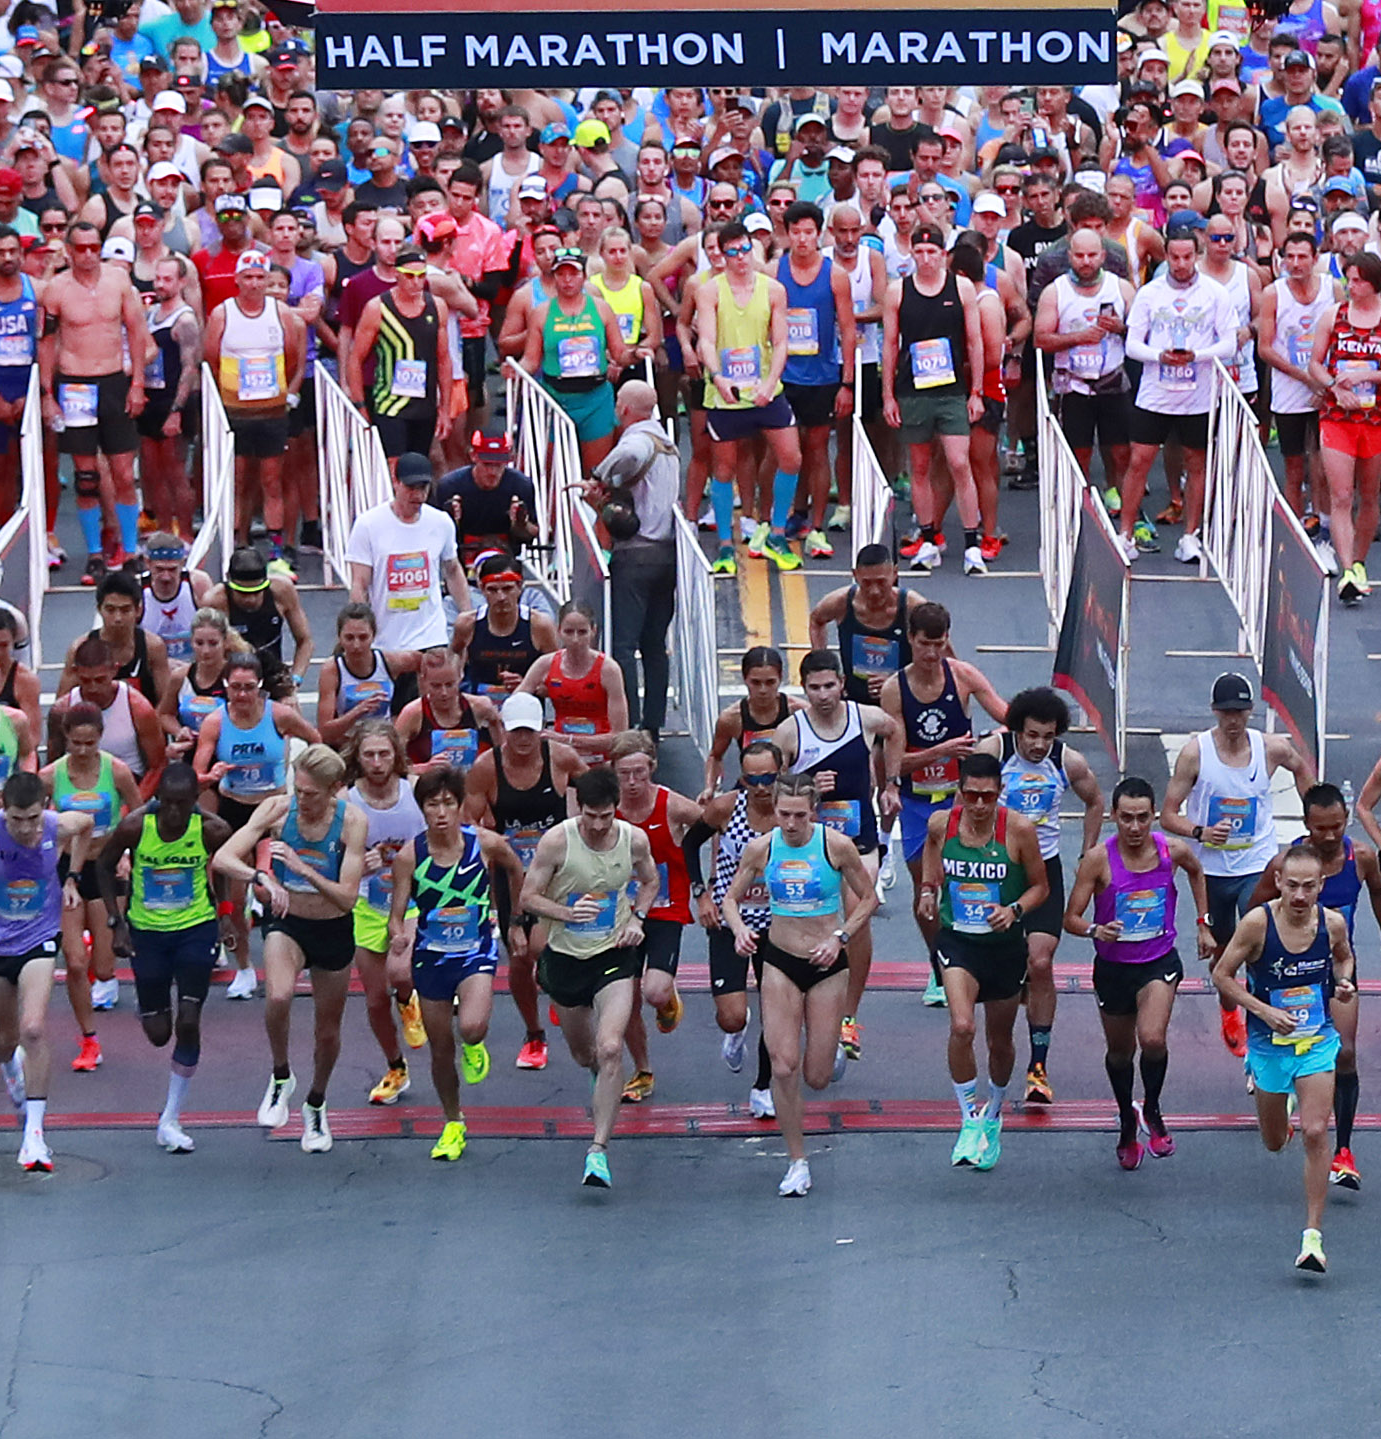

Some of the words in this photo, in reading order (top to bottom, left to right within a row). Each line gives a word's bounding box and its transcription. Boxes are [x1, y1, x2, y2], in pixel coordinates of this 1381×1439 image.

[325, 34, 450, 70] HALF
[466, 32, 746, 69] MARATHON
[821, 29, 1112, 66] MARATHON
[726, 361, 757, 375] 1019
[389, 569, 429, 586] 21061
[922, 766, 945, 778] 112
[941, 858, 1008, 880] MEXICO
[785, 881, 806, 896] 53
[963, 905, 985, 918] 34
[1135, 912, 1147, 925] 7
